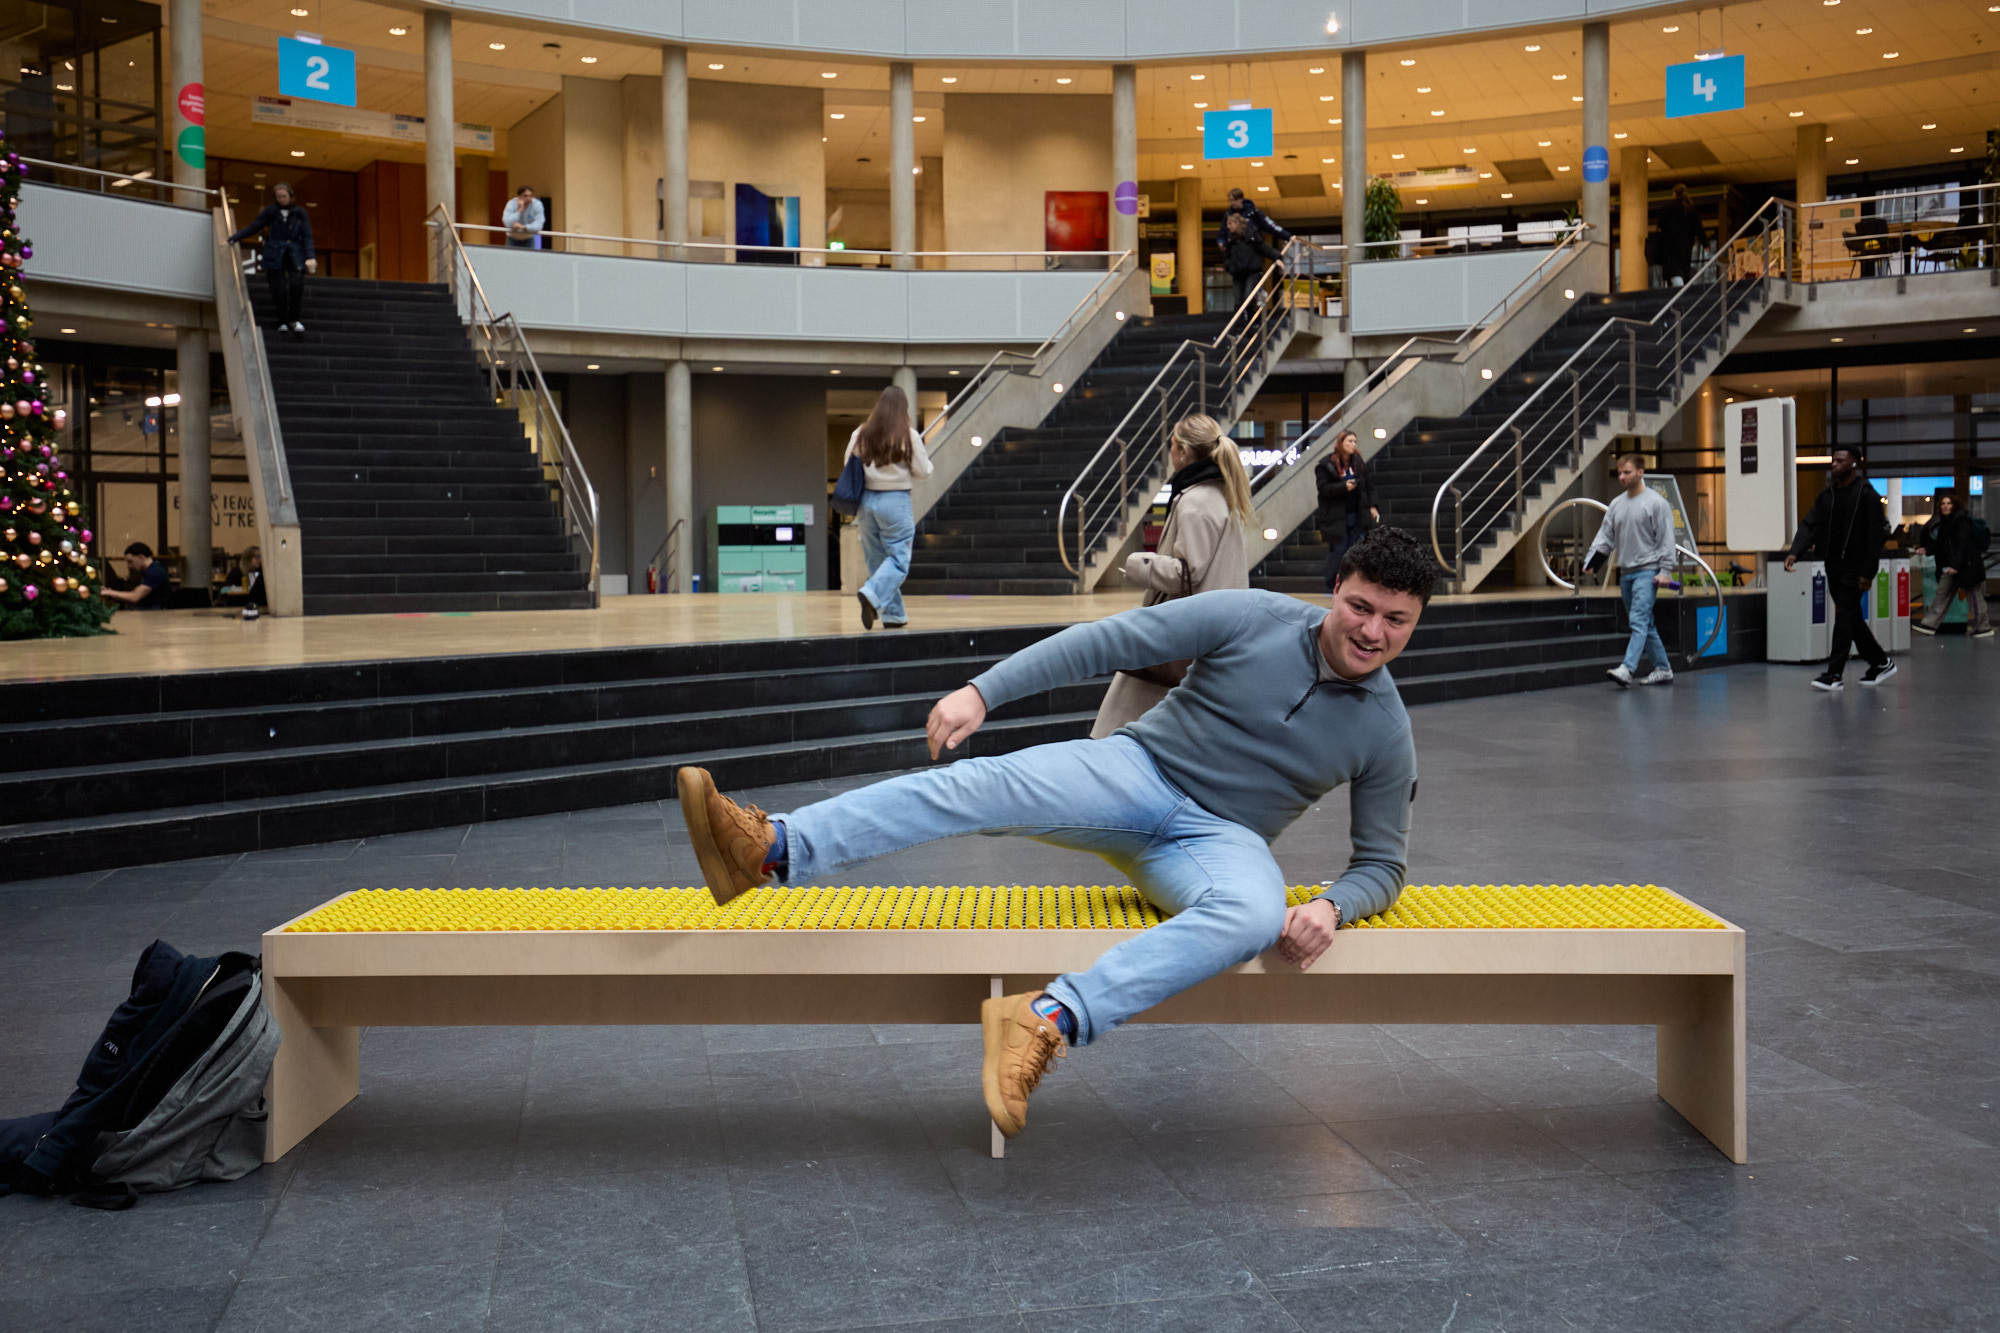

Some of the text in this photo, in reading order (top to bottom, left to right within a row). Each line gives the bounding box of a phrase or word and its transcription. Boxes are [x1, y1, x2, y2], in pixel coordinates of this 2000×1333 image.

[306, 56, 330, 90] 2
[1693, 73, 1717, 102] 4
[1227, 120, 1249, 149] 3
